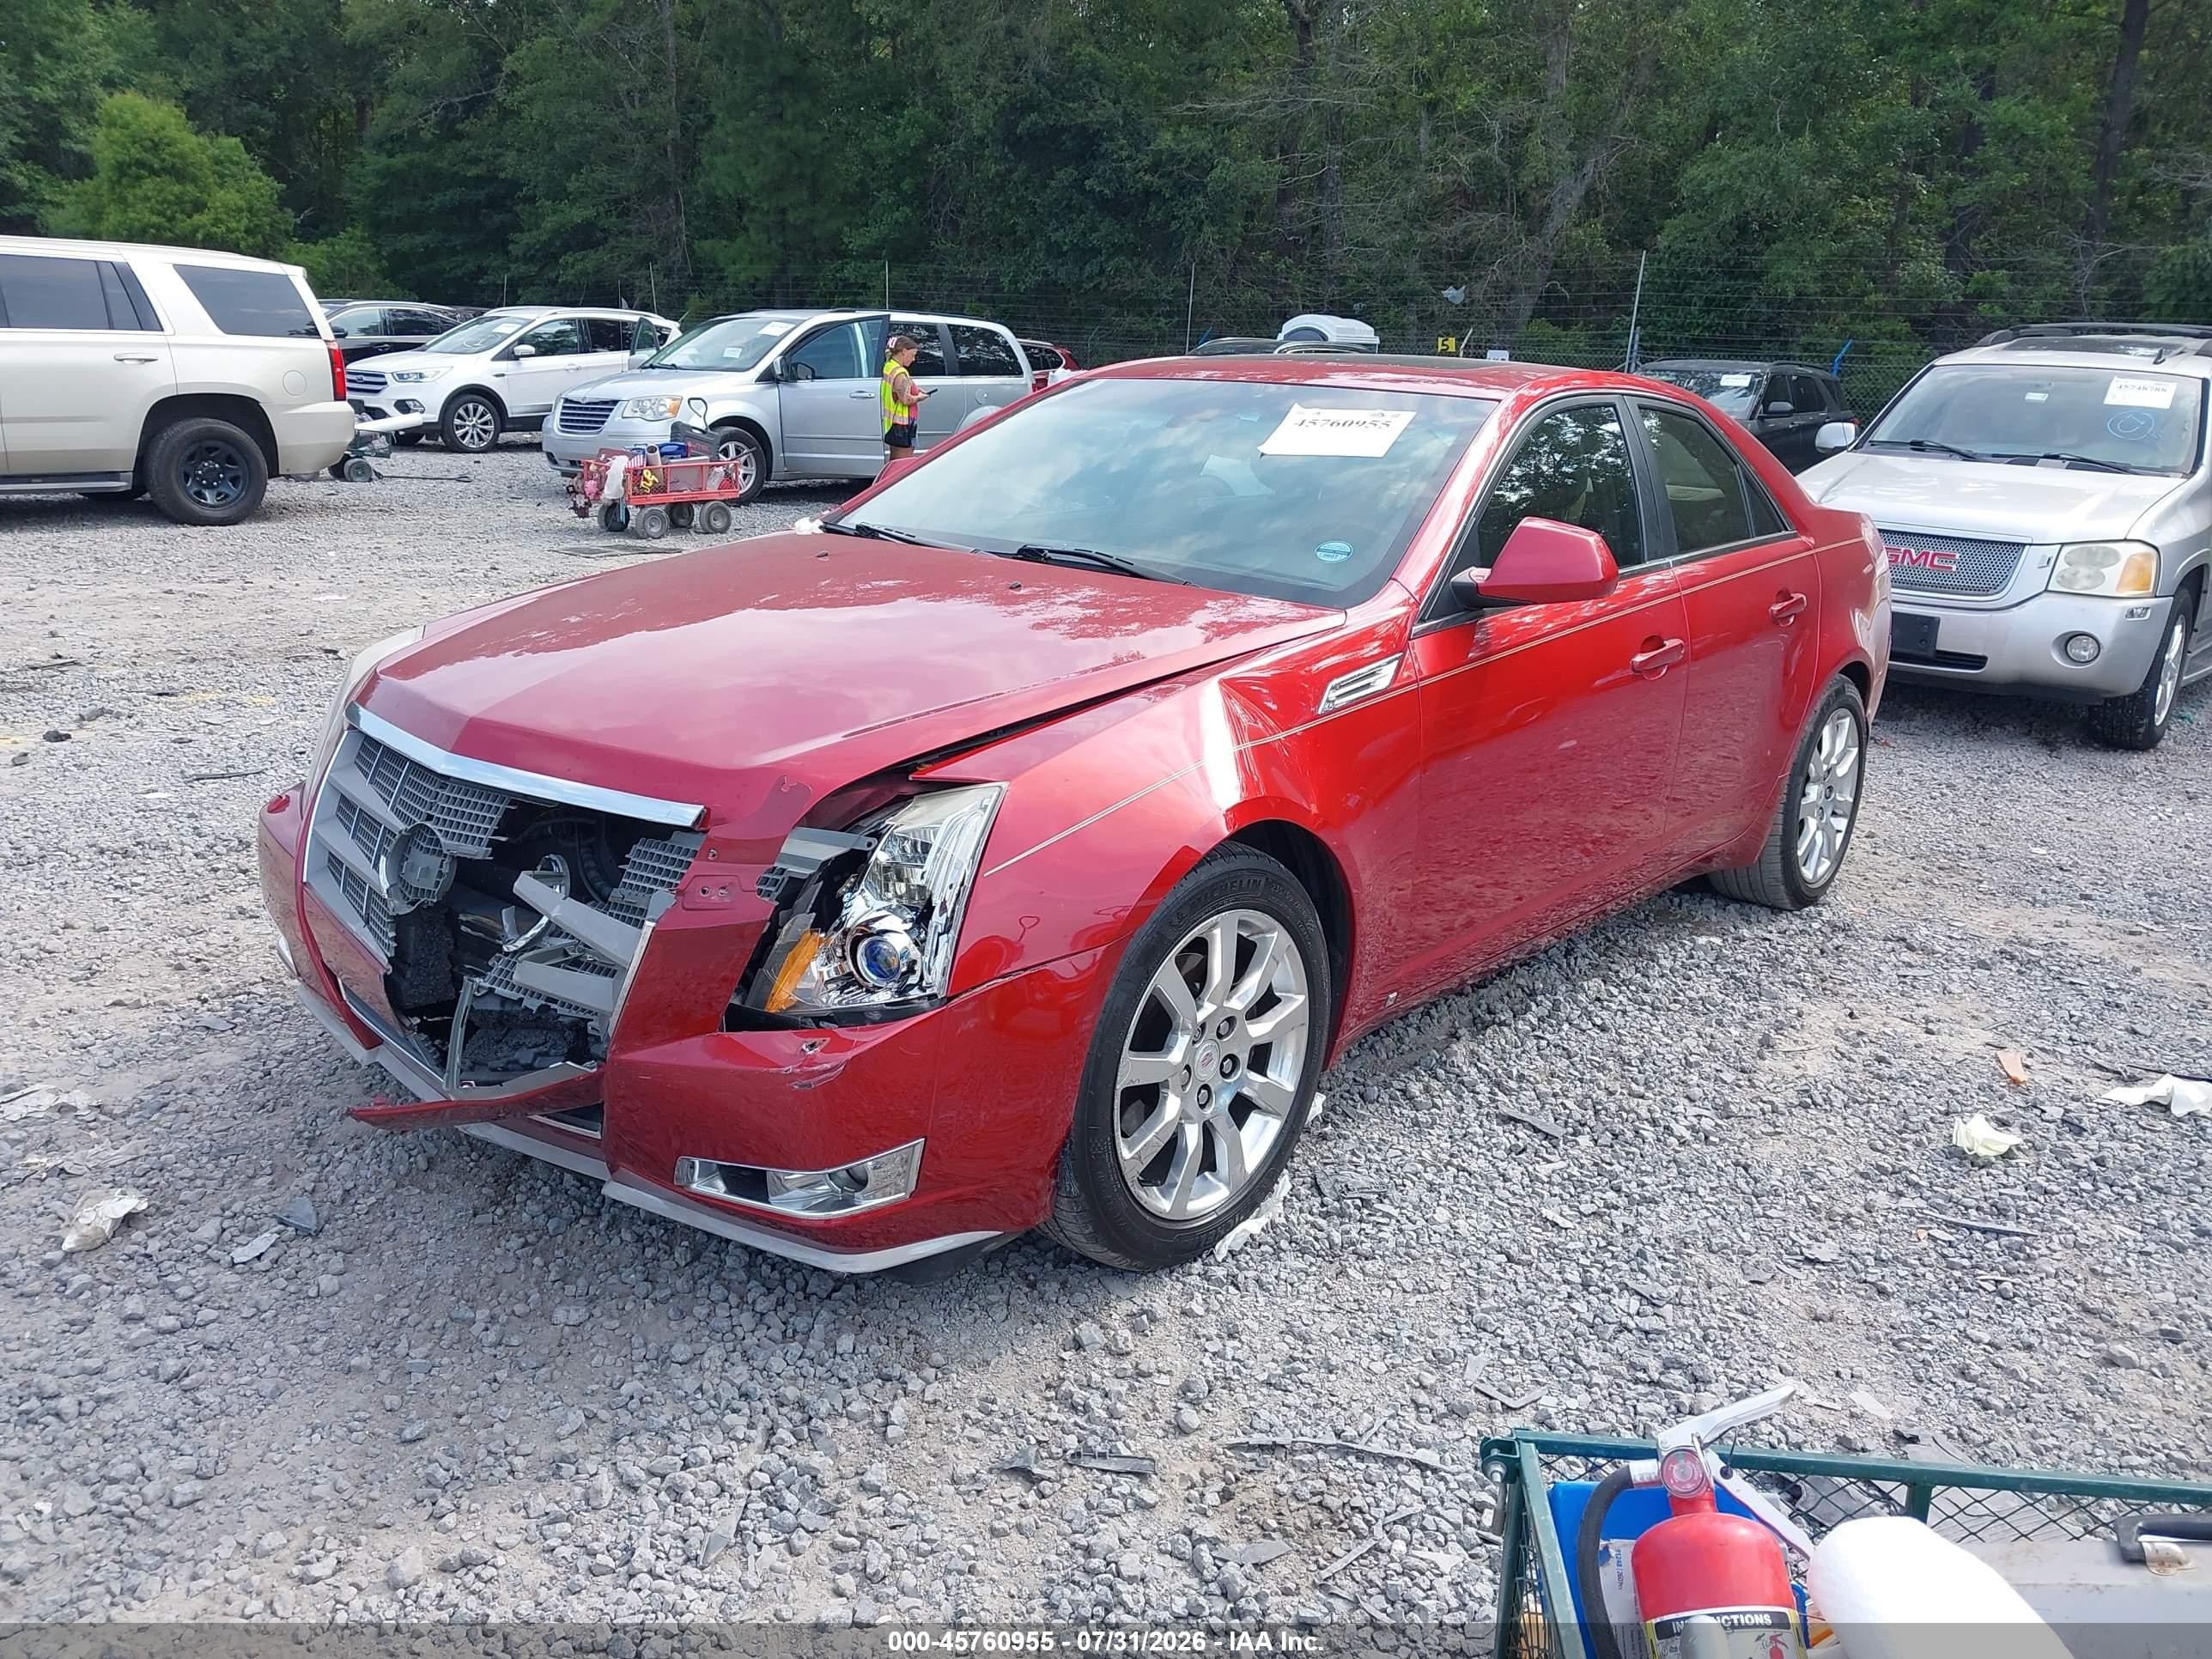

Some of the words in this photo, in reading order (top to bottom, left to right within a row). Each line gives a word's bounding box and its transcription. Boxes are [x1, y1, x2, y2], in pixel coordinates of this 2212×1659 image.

[1440, 337, 1450, 351] 5
[1293, 418, 1392, 429] 45760955
[1884, 545, 1958, 572] GMC
[1672, 1613, 1772, 1634] INCTIONS
